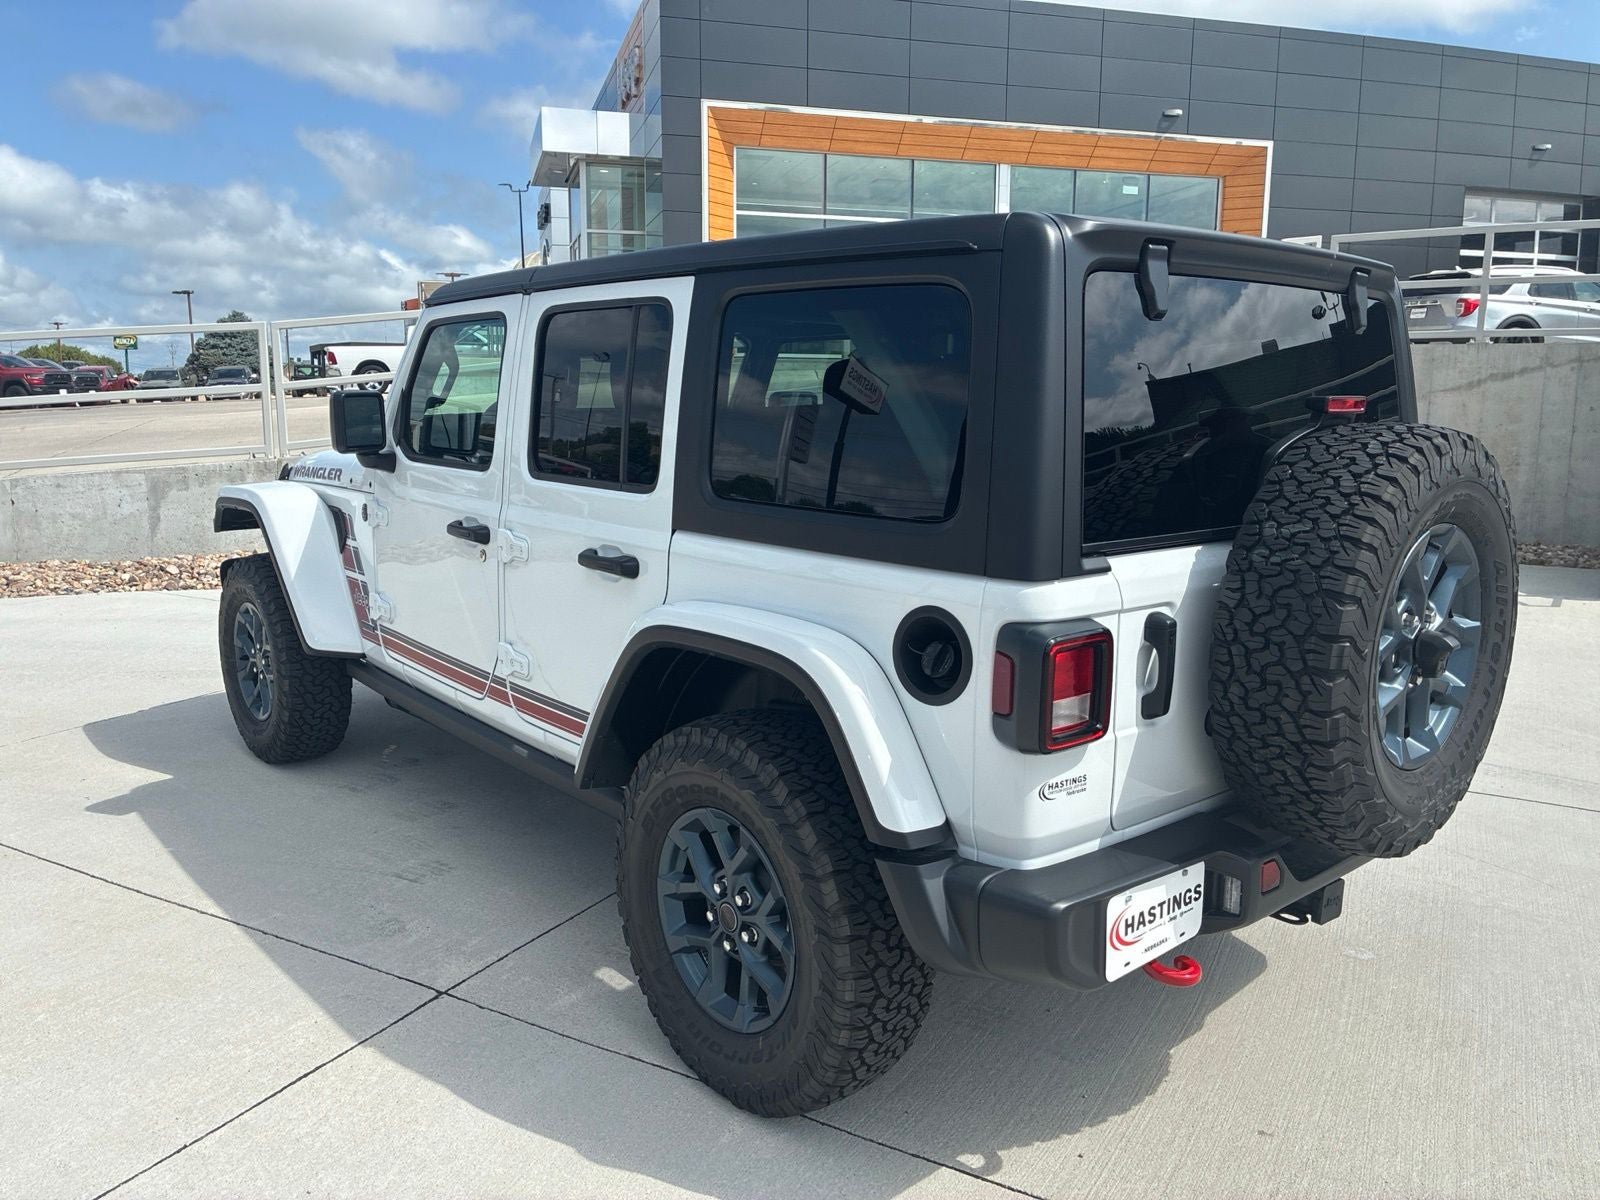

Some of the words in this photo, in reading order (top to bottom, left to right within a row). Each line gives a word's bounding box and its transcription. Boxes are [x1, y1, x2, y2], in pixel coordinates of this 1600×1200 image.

[293, 465, 342, 482] WRANGLER
[1047, 774, 1087, 790] HASTINGS
[1124, 883, 1202, 936] HASTINGS
